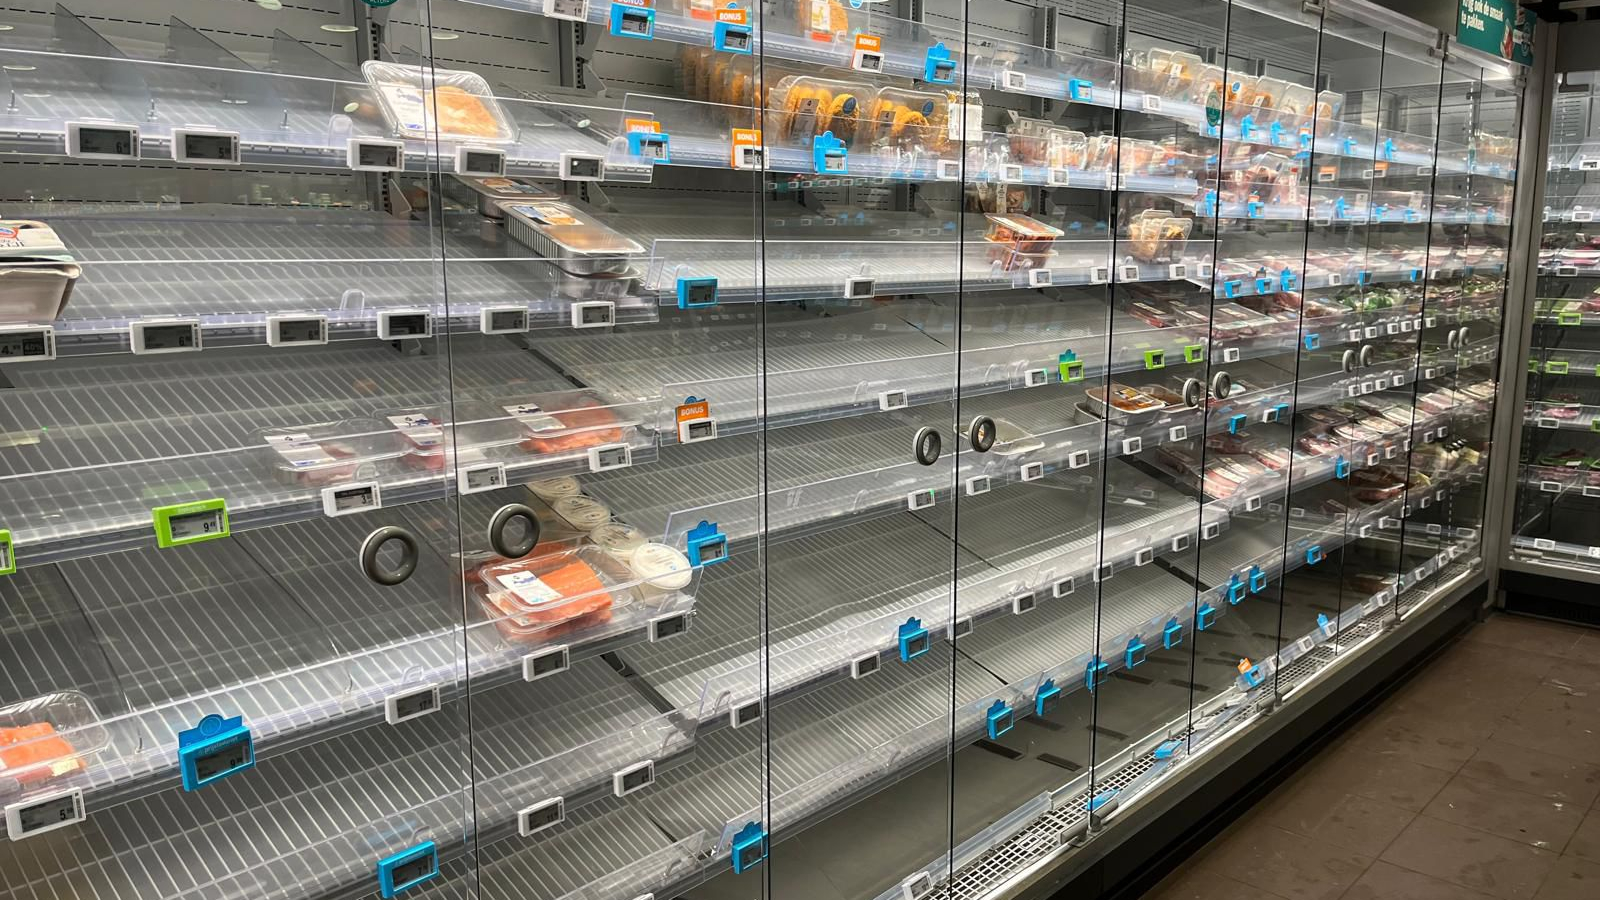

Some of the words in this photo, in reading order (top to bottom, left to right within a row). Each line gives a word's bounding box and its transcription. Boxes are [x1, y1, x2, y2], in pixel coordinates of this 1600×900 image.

[720, 12, 742, 21] BONUS
[1483, 1, 1490, 16] de
[1490, 6, 1503, 22] smaak
[1461, 10, 1467, 25] te
[1466, 13, 1485, 30] pakken.
[681, 405, 705, 417] BONUS
